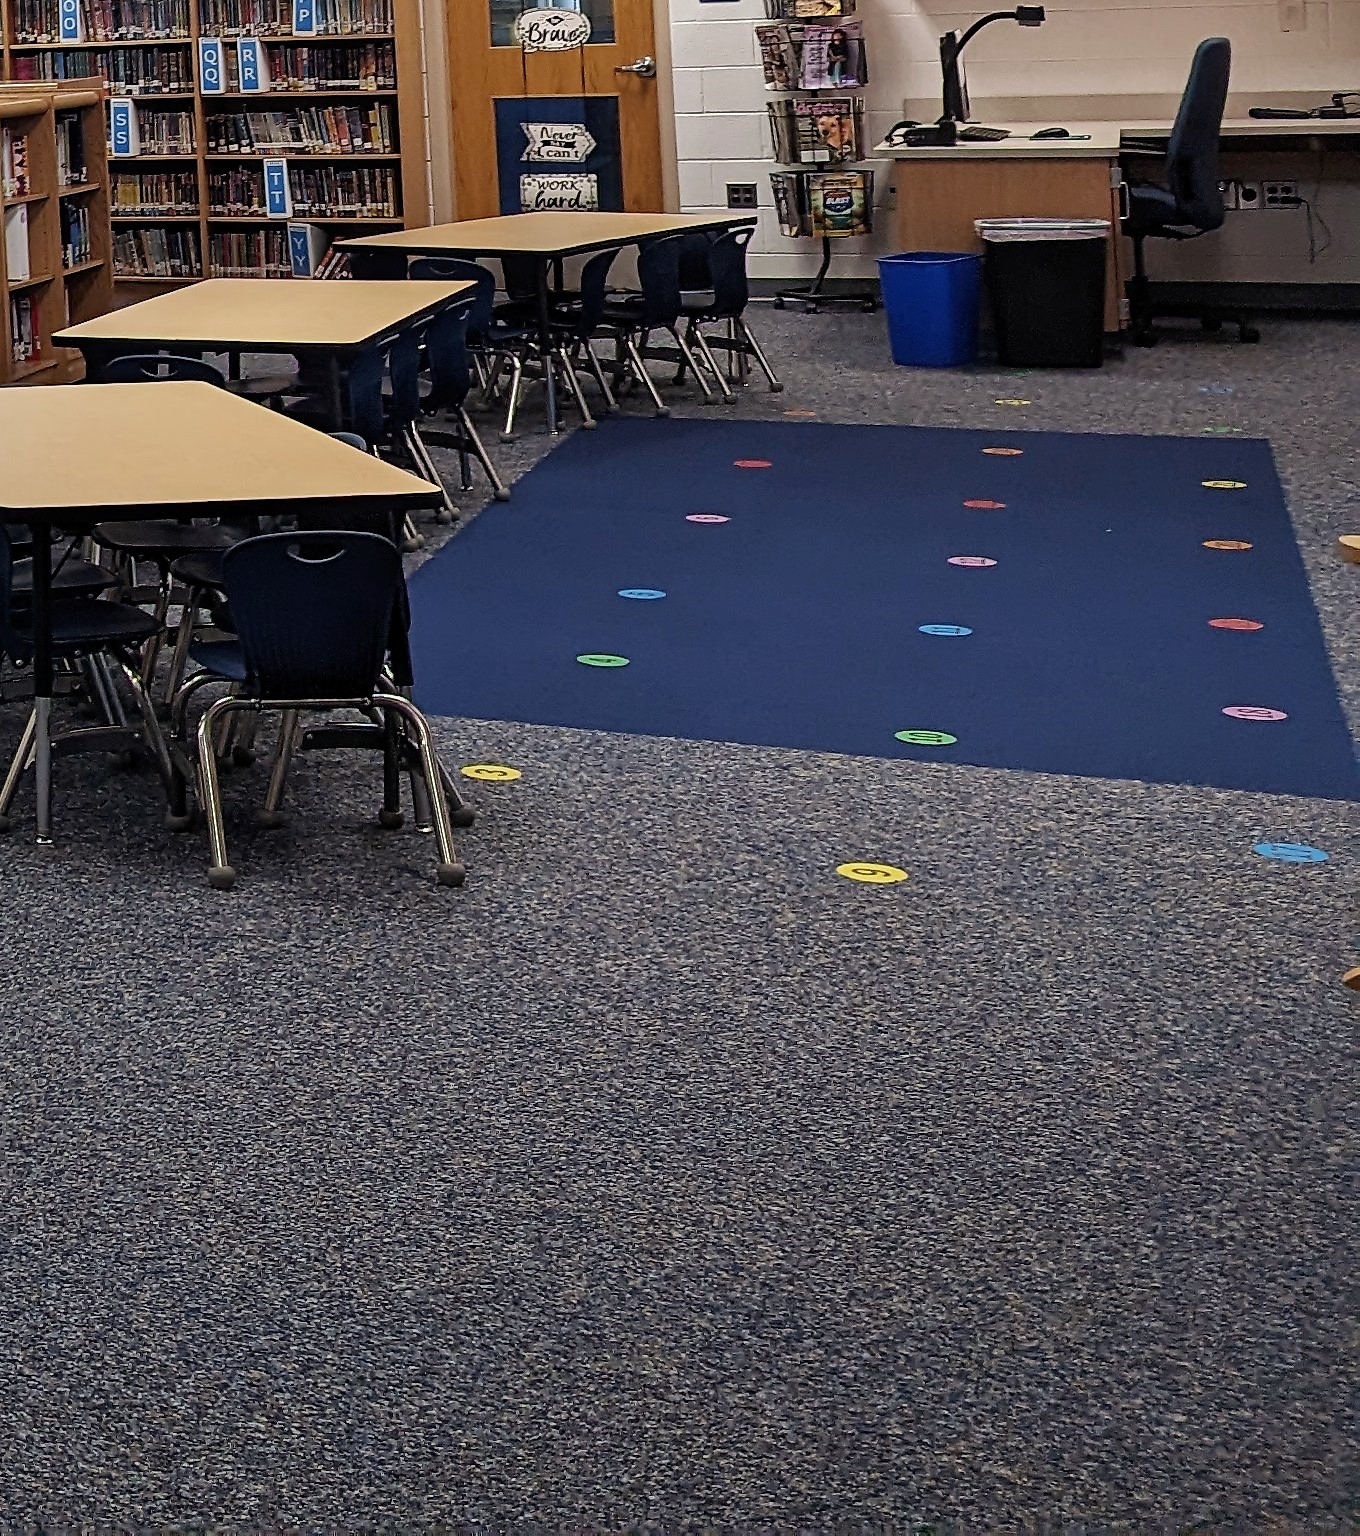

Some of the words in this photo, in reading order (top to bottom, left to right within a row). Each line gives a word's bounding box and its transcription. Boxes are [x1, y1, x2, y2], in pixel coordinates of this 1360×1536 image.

[526, 22, 580, 44] Brave
[540, 126, 578, 141] Never
[537, 180, 579, 191] WORK
[534, 190, 587, 209] hard
[908, 732, 943, 743] 10
[474, 768, 508, 777] 3
[851, 868, 891, 877] 9
